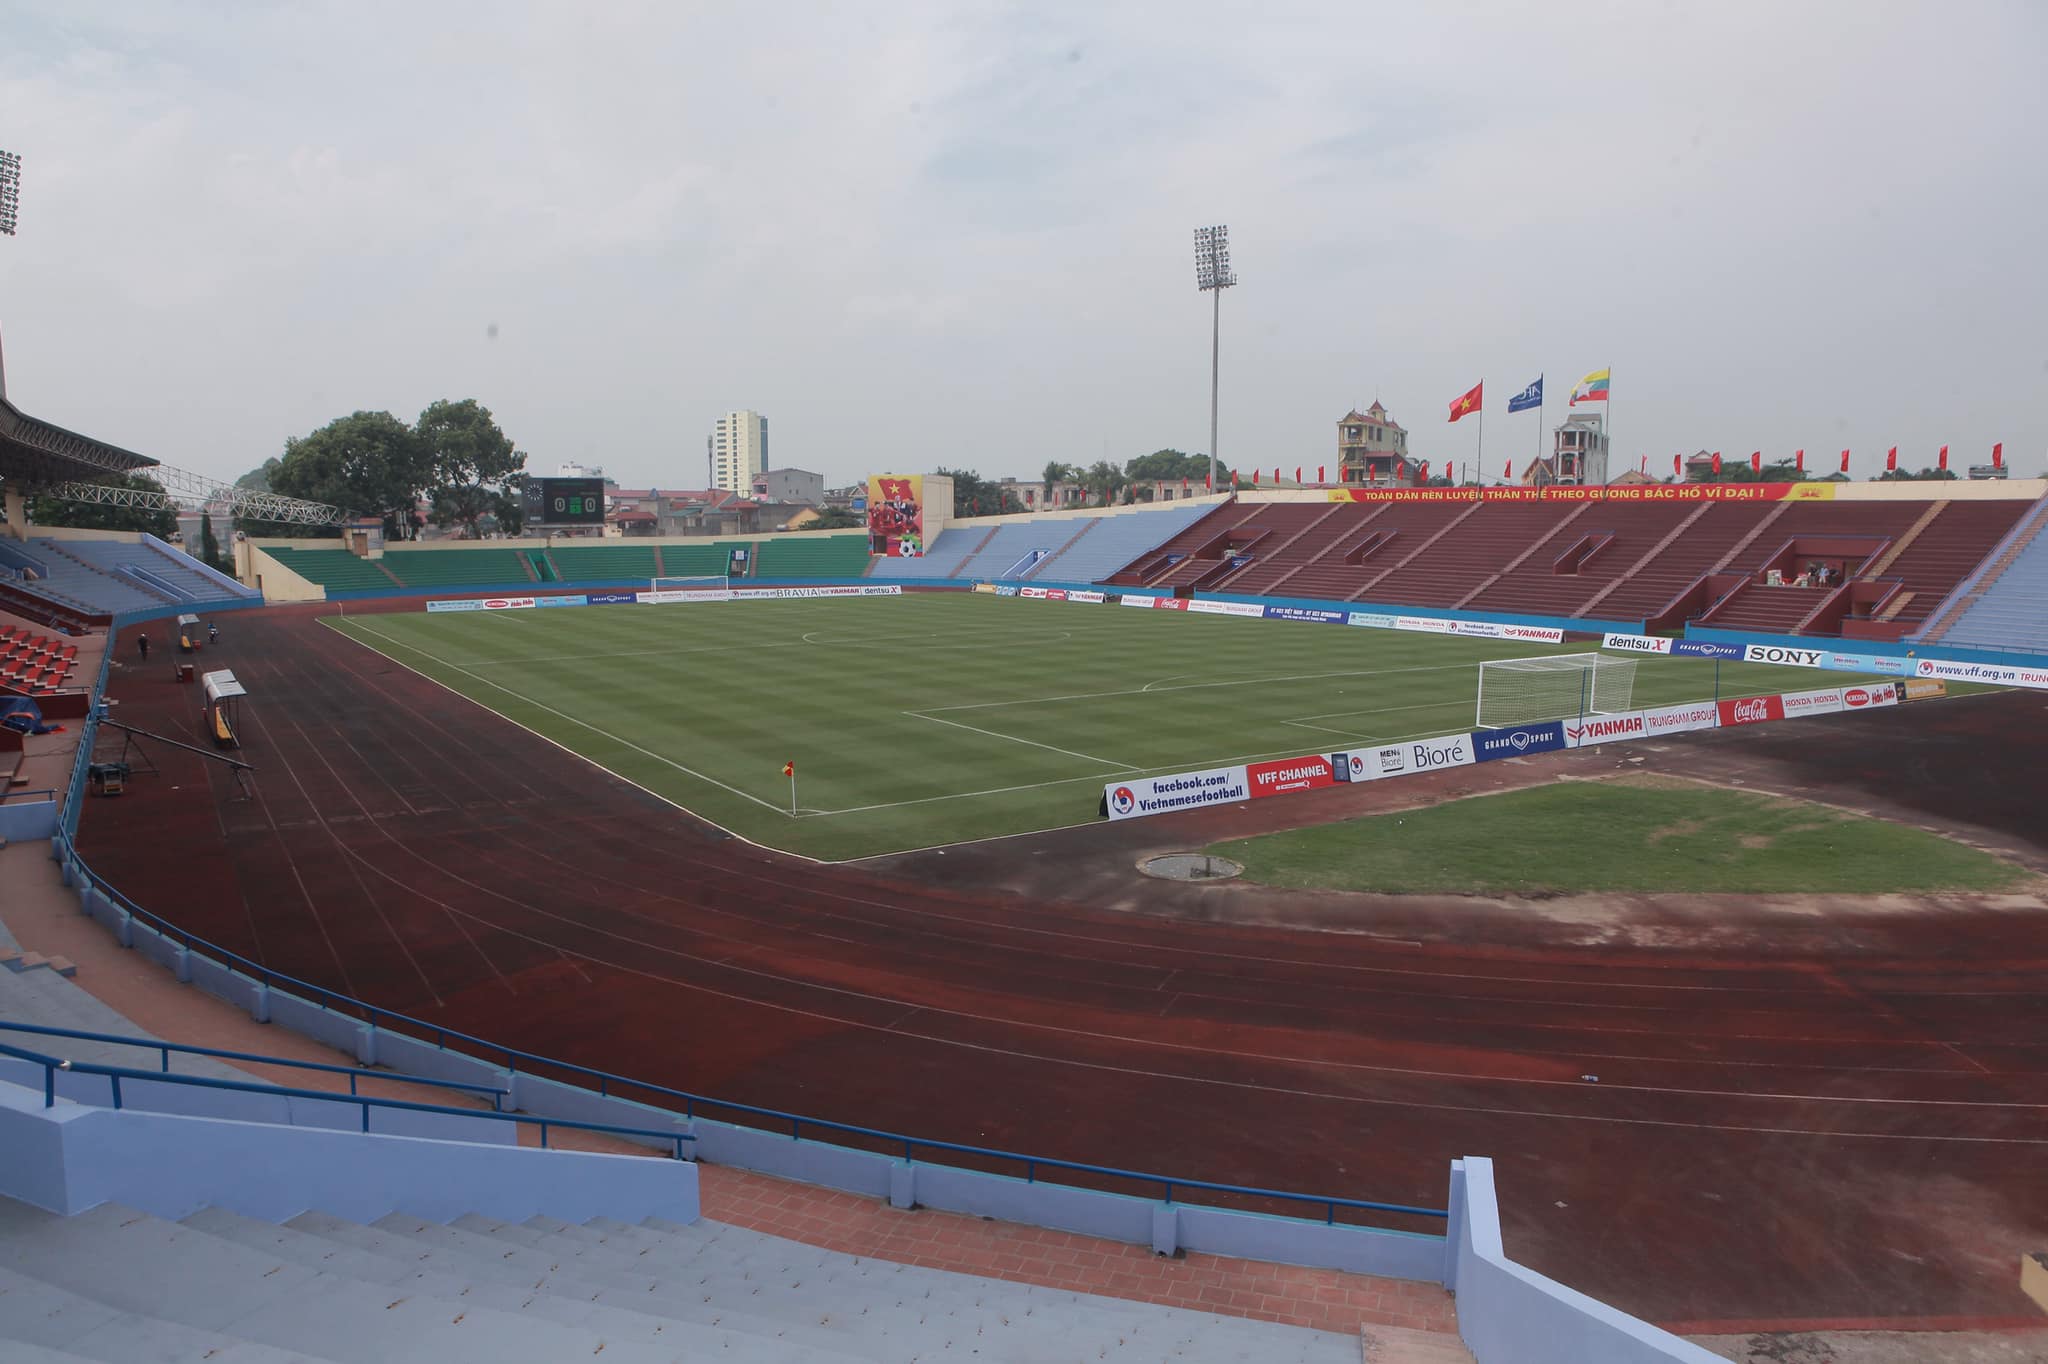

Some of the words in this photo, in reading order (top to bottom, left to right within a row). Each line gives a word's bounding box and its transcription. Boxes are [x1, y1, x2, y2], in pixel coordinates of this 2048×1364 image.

[1366, 488, 1392, 500] TOÀN
[1396, 489, 1418, 500] DÂN
[1487, 489, 1520, 499] THÂN
[1551, 489, 1585, 499] THEO
[1644, 487, 1674, 498] BÁC
[1725, 488, 1753, 500] ĐẠI
[777, 588, 818, 598] BRAVIA
[1517, 628, 1560, 640] YANMAR
[1609, 636, 1650, 649] dentsu
[1750, 647, 1821, 665] SONY
[1935, 665, 2015, 680] www.vff.org.vn
[1785, 698, 1812, 707] HONDA
[1814, 694, 1840, 704] HONDA
[1585, 717, 1643, 738] YANMAR
[1648, 712, 1690, 728] TRUNGNAM
[1484, 738, 1510, 750] GRAND
[1530, 732, 1554, 743] SPORT
[1413, 739, 1463, 767] Bioré
[1153, 772, 1230, 794] facebook.com/
[1257, 772, 1278, 785] VFF
[1279, 764, 1328, 781] CHANNEL
[1139, 785, 1243, 811] Vietnamesefootball
